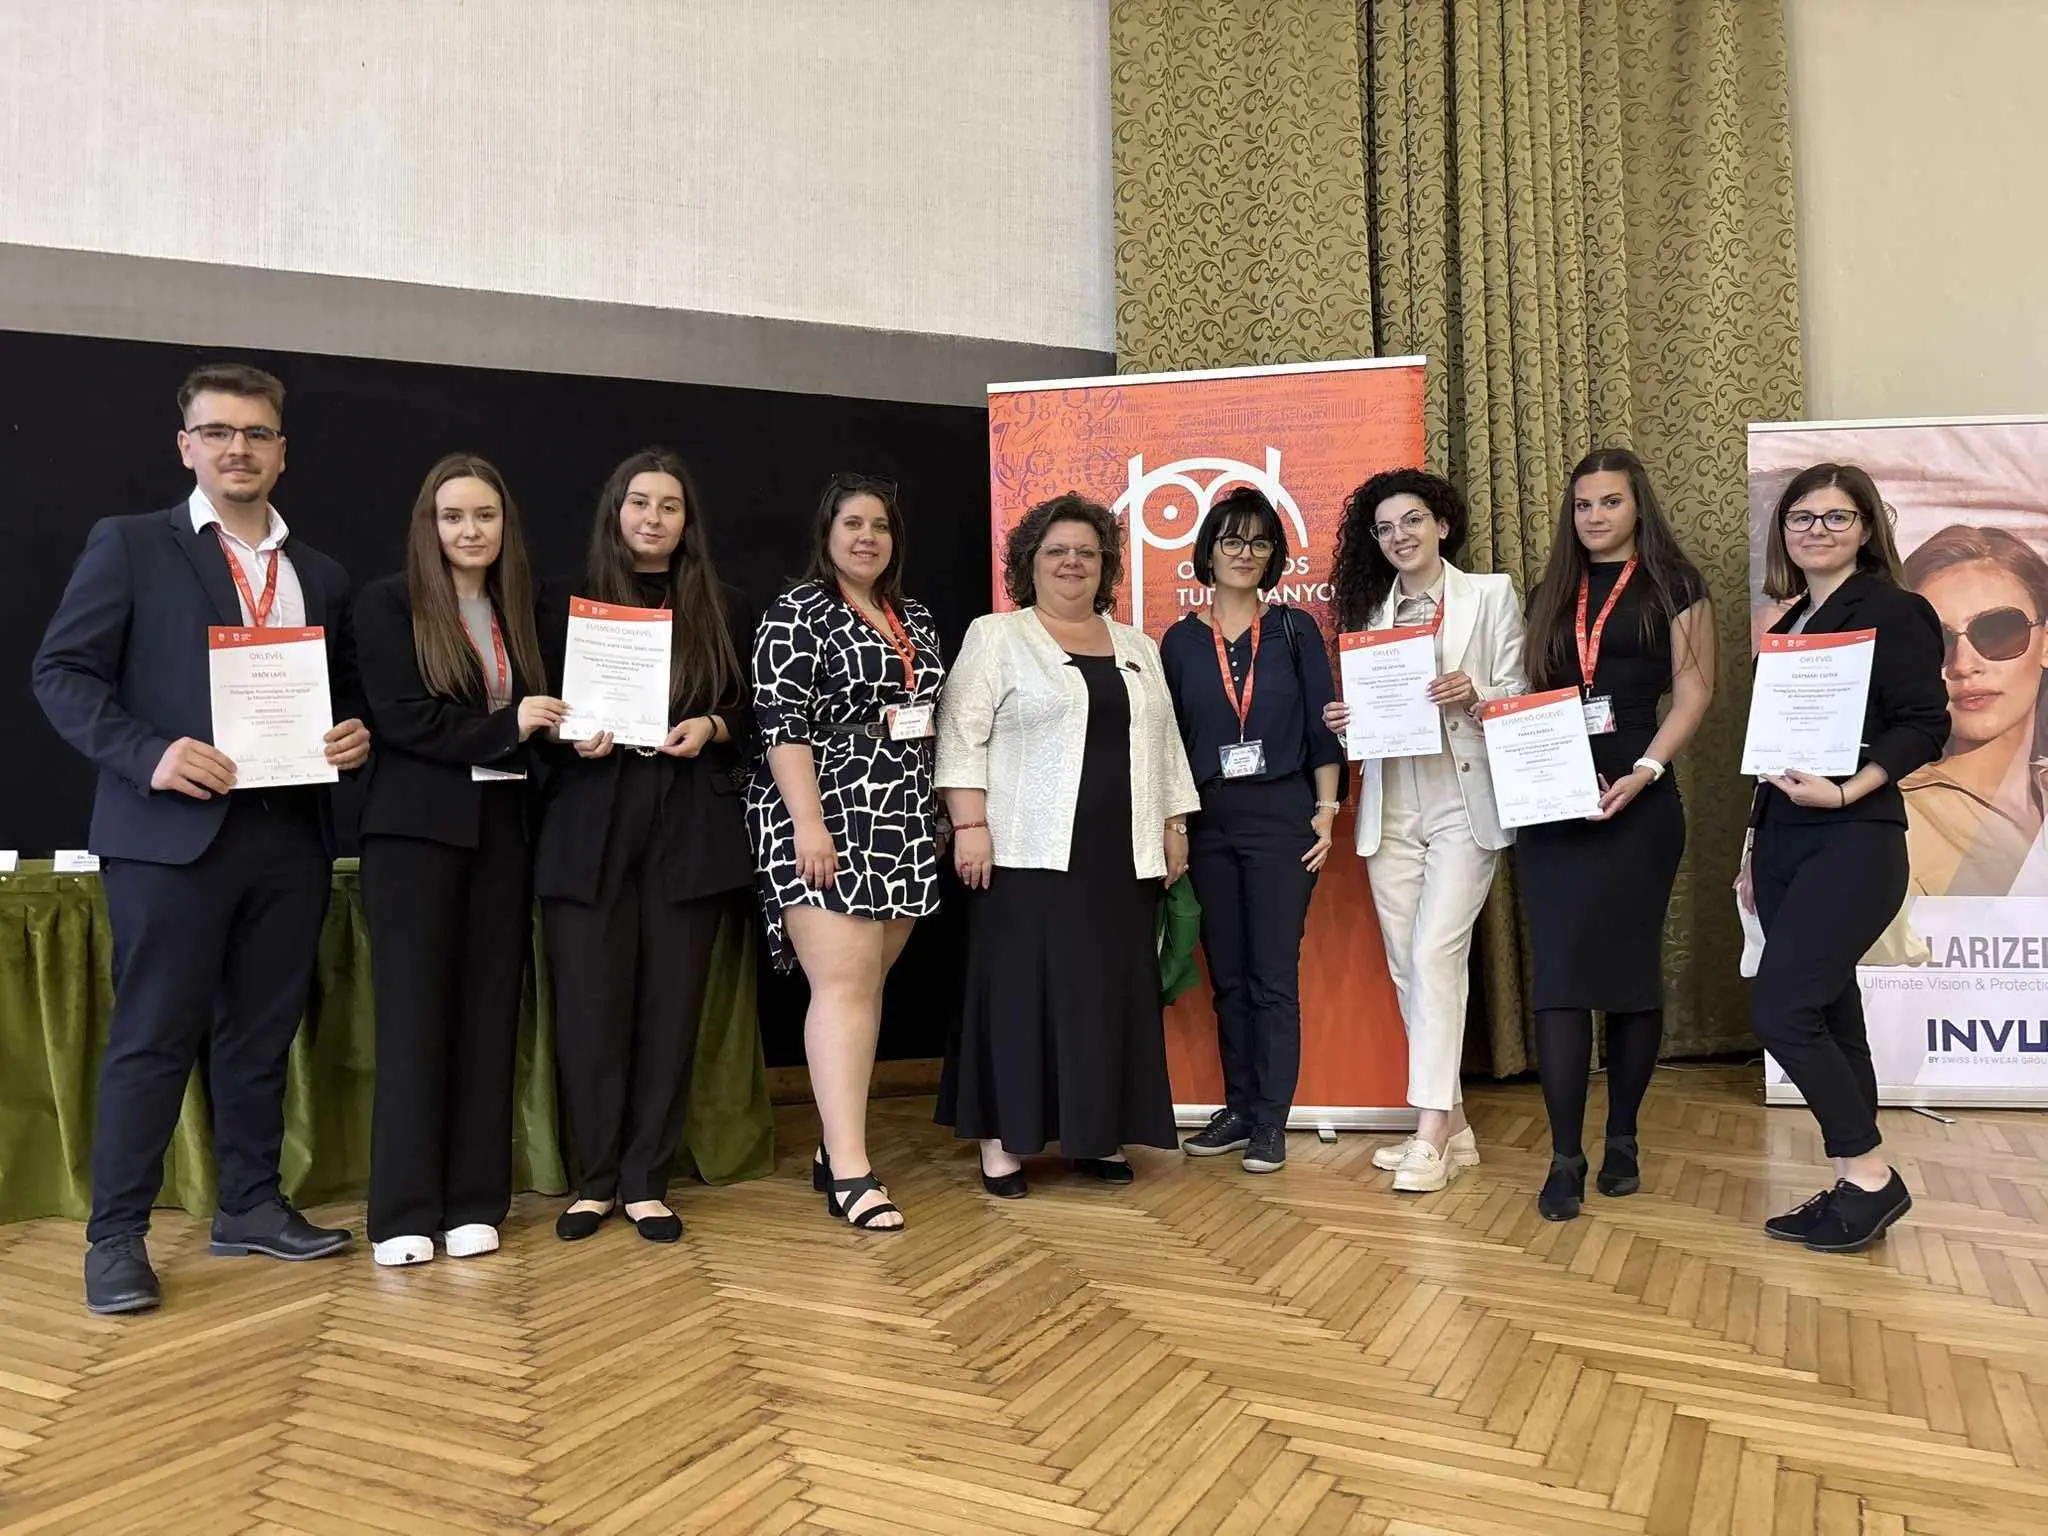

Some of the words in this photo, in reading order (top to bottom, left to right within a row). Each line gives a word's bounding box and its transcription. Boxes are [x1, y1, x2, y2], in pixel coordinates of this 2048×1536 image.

[1926, 936, 2048, 969] LARIZE
[1863, 976, 1923, 990] Ultimate
[1927, 977, 1970, 990] Vision
[1975, 978, 1985, 990] &
[1927, 1019, 2048, 1052] INVU
[1928, 1056, 1939, 1064] BY
[1942, 1056, 1970, 1064] SWISS
[1973, 1056, 2018, 1065] EYEWEAR
